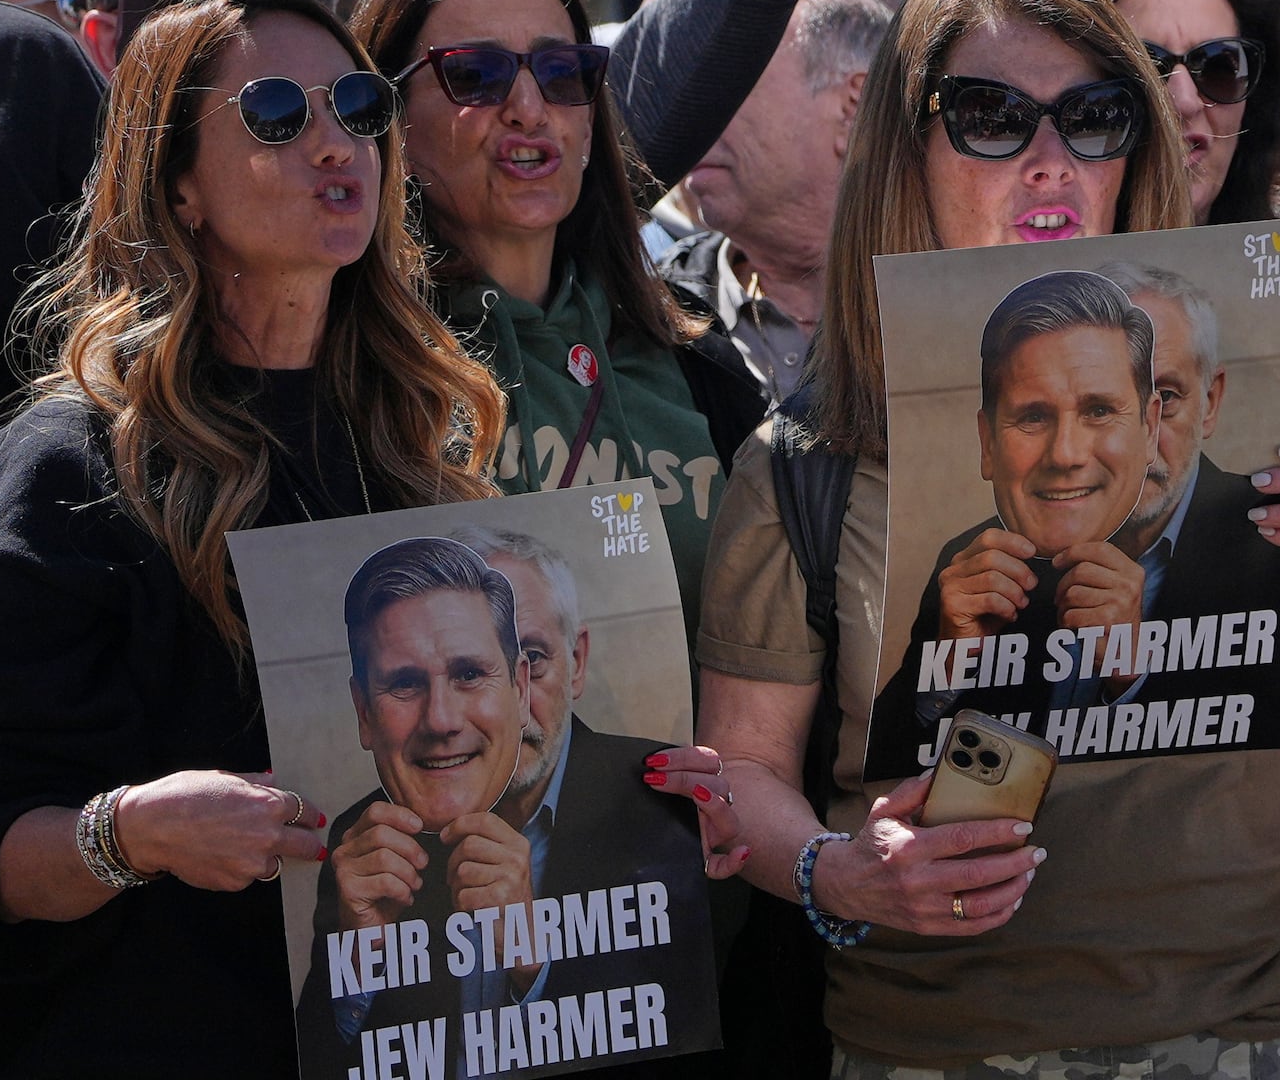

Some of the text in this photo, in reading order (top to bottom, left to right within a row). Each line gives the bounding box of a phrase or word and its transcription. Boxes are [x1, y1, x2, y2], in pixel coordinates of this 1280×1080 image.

[602, 513, 643, 536] THE
[602, 531, 652, 559] HATE
[916, 609, 1278, 695] KEIR STARMER
[1044, 693, 1256, 758] HARMER
[326, 880, 672, 1000] KEIR STARMER
[347, 981, 669, 1080] JEW HARMER
